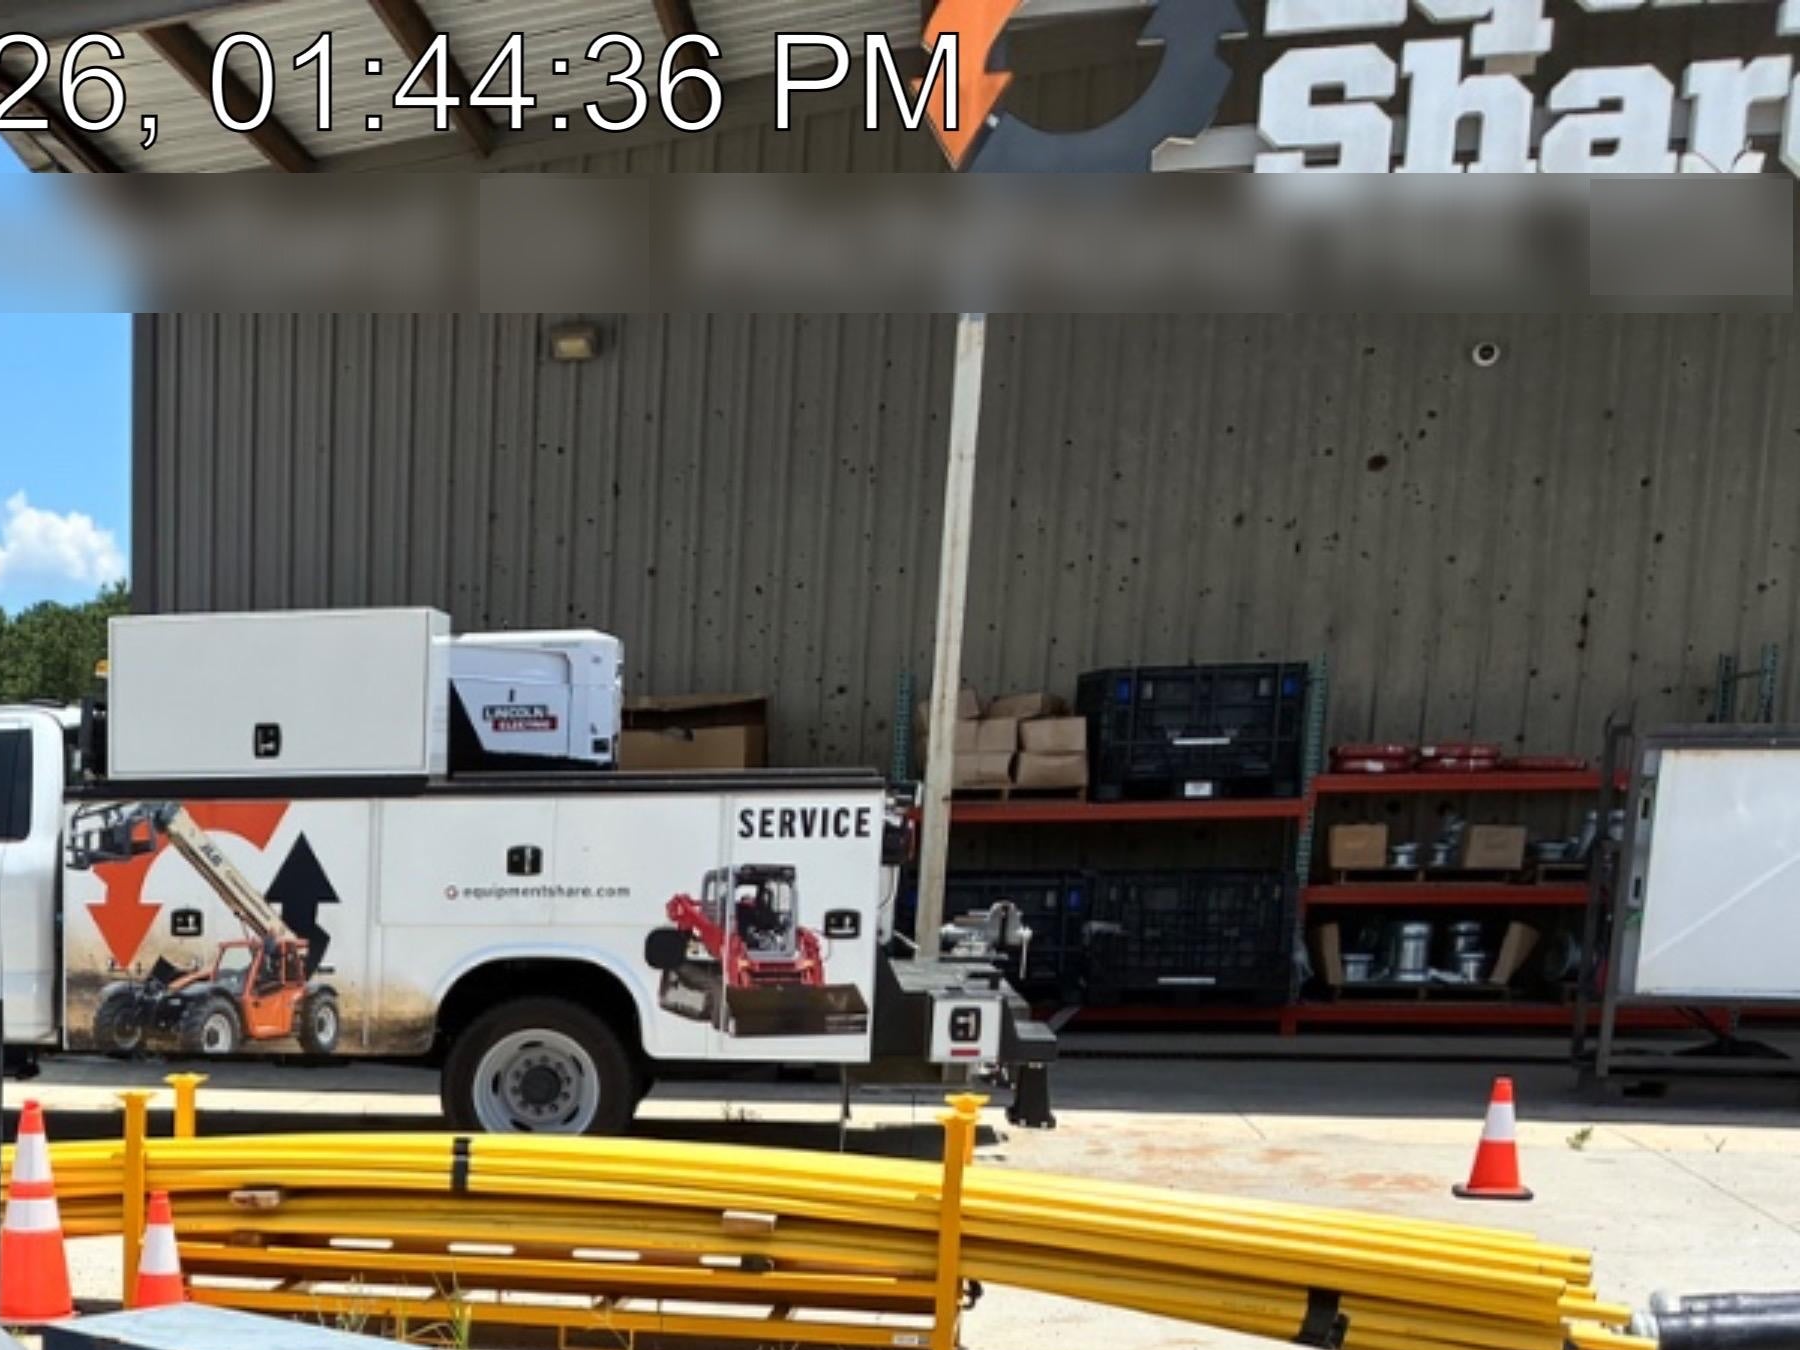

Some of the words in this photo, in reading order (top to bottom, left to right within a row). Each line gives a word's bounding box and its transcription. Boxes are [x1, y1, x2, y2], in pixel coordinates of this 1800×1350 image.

[1253, 38, 1800, 174] Shar
[738, 807, 871, 838] SERVICE
[464, 885, 630, 899] equipmentshare.com
